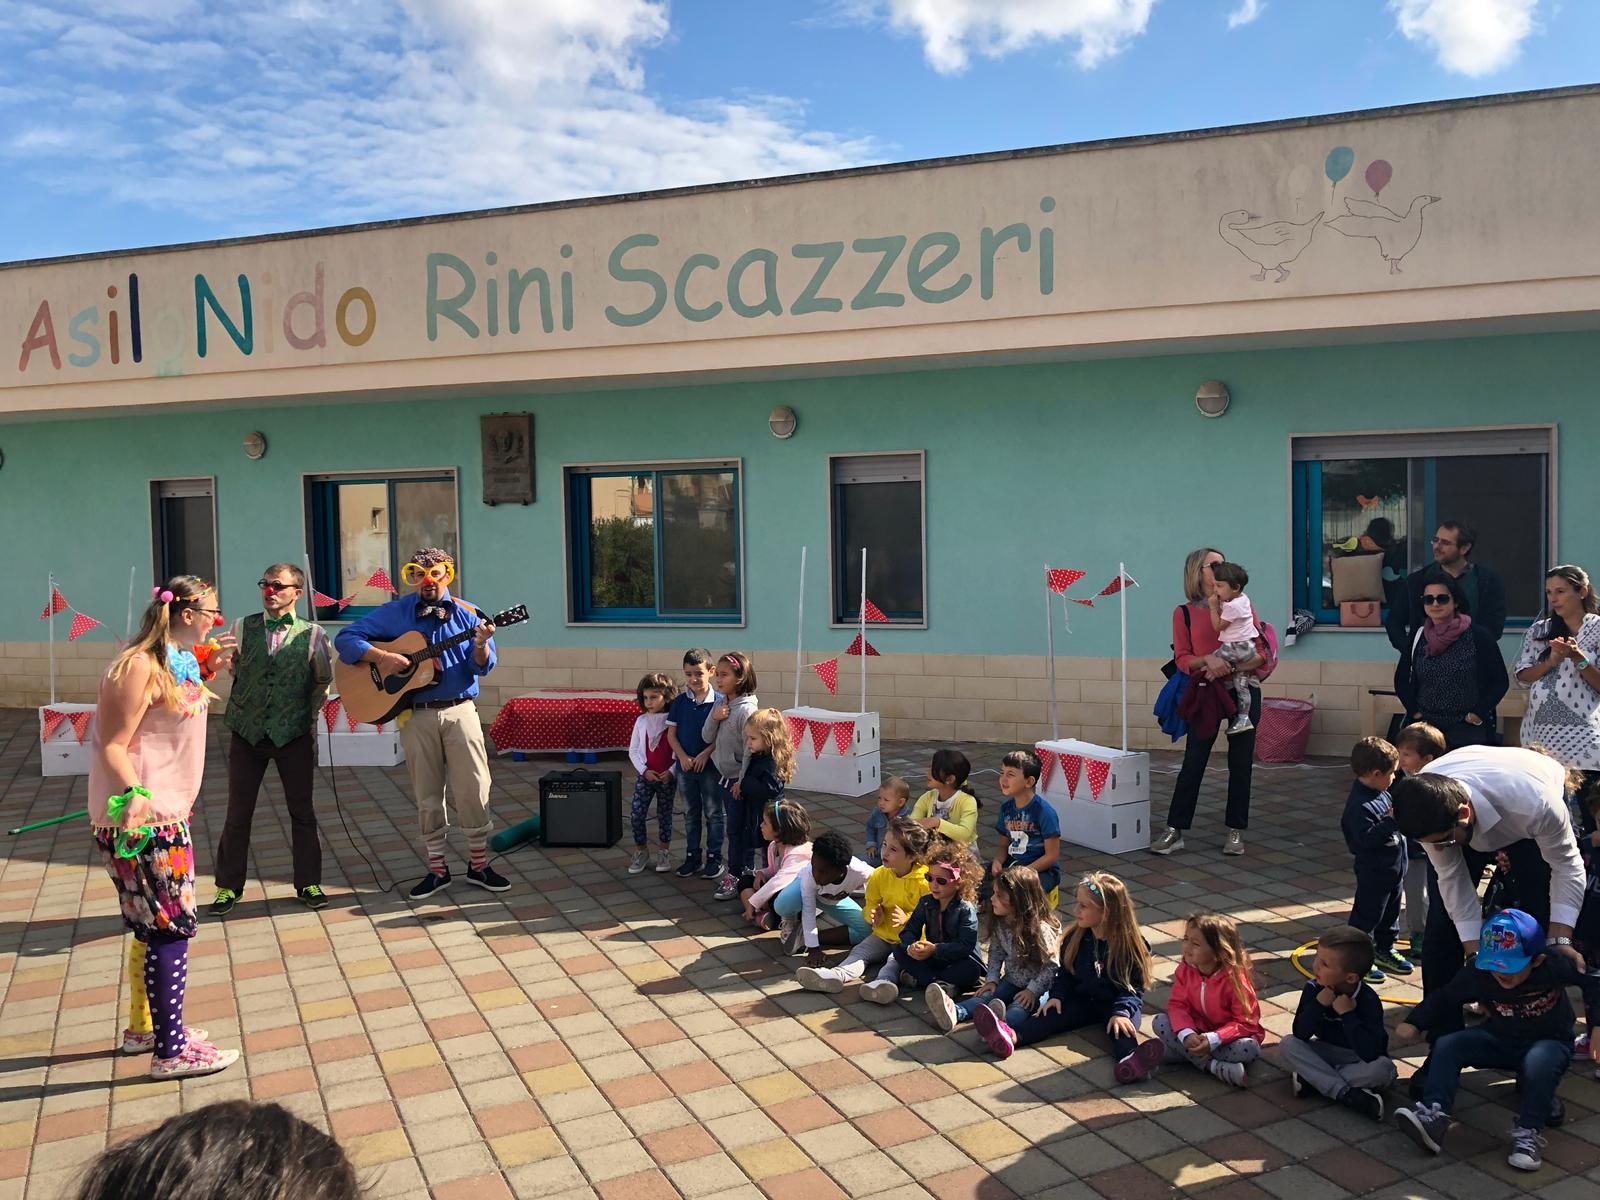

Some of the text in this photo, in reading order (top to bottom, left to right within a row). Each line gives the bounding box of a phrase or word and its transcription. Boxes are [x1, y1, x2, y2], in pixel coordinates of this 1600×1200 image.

[195, 261, 377, 358] Nido
[426, 243, 574, 342] Rini
[604, 195, 1056, 328] Scazzeri
